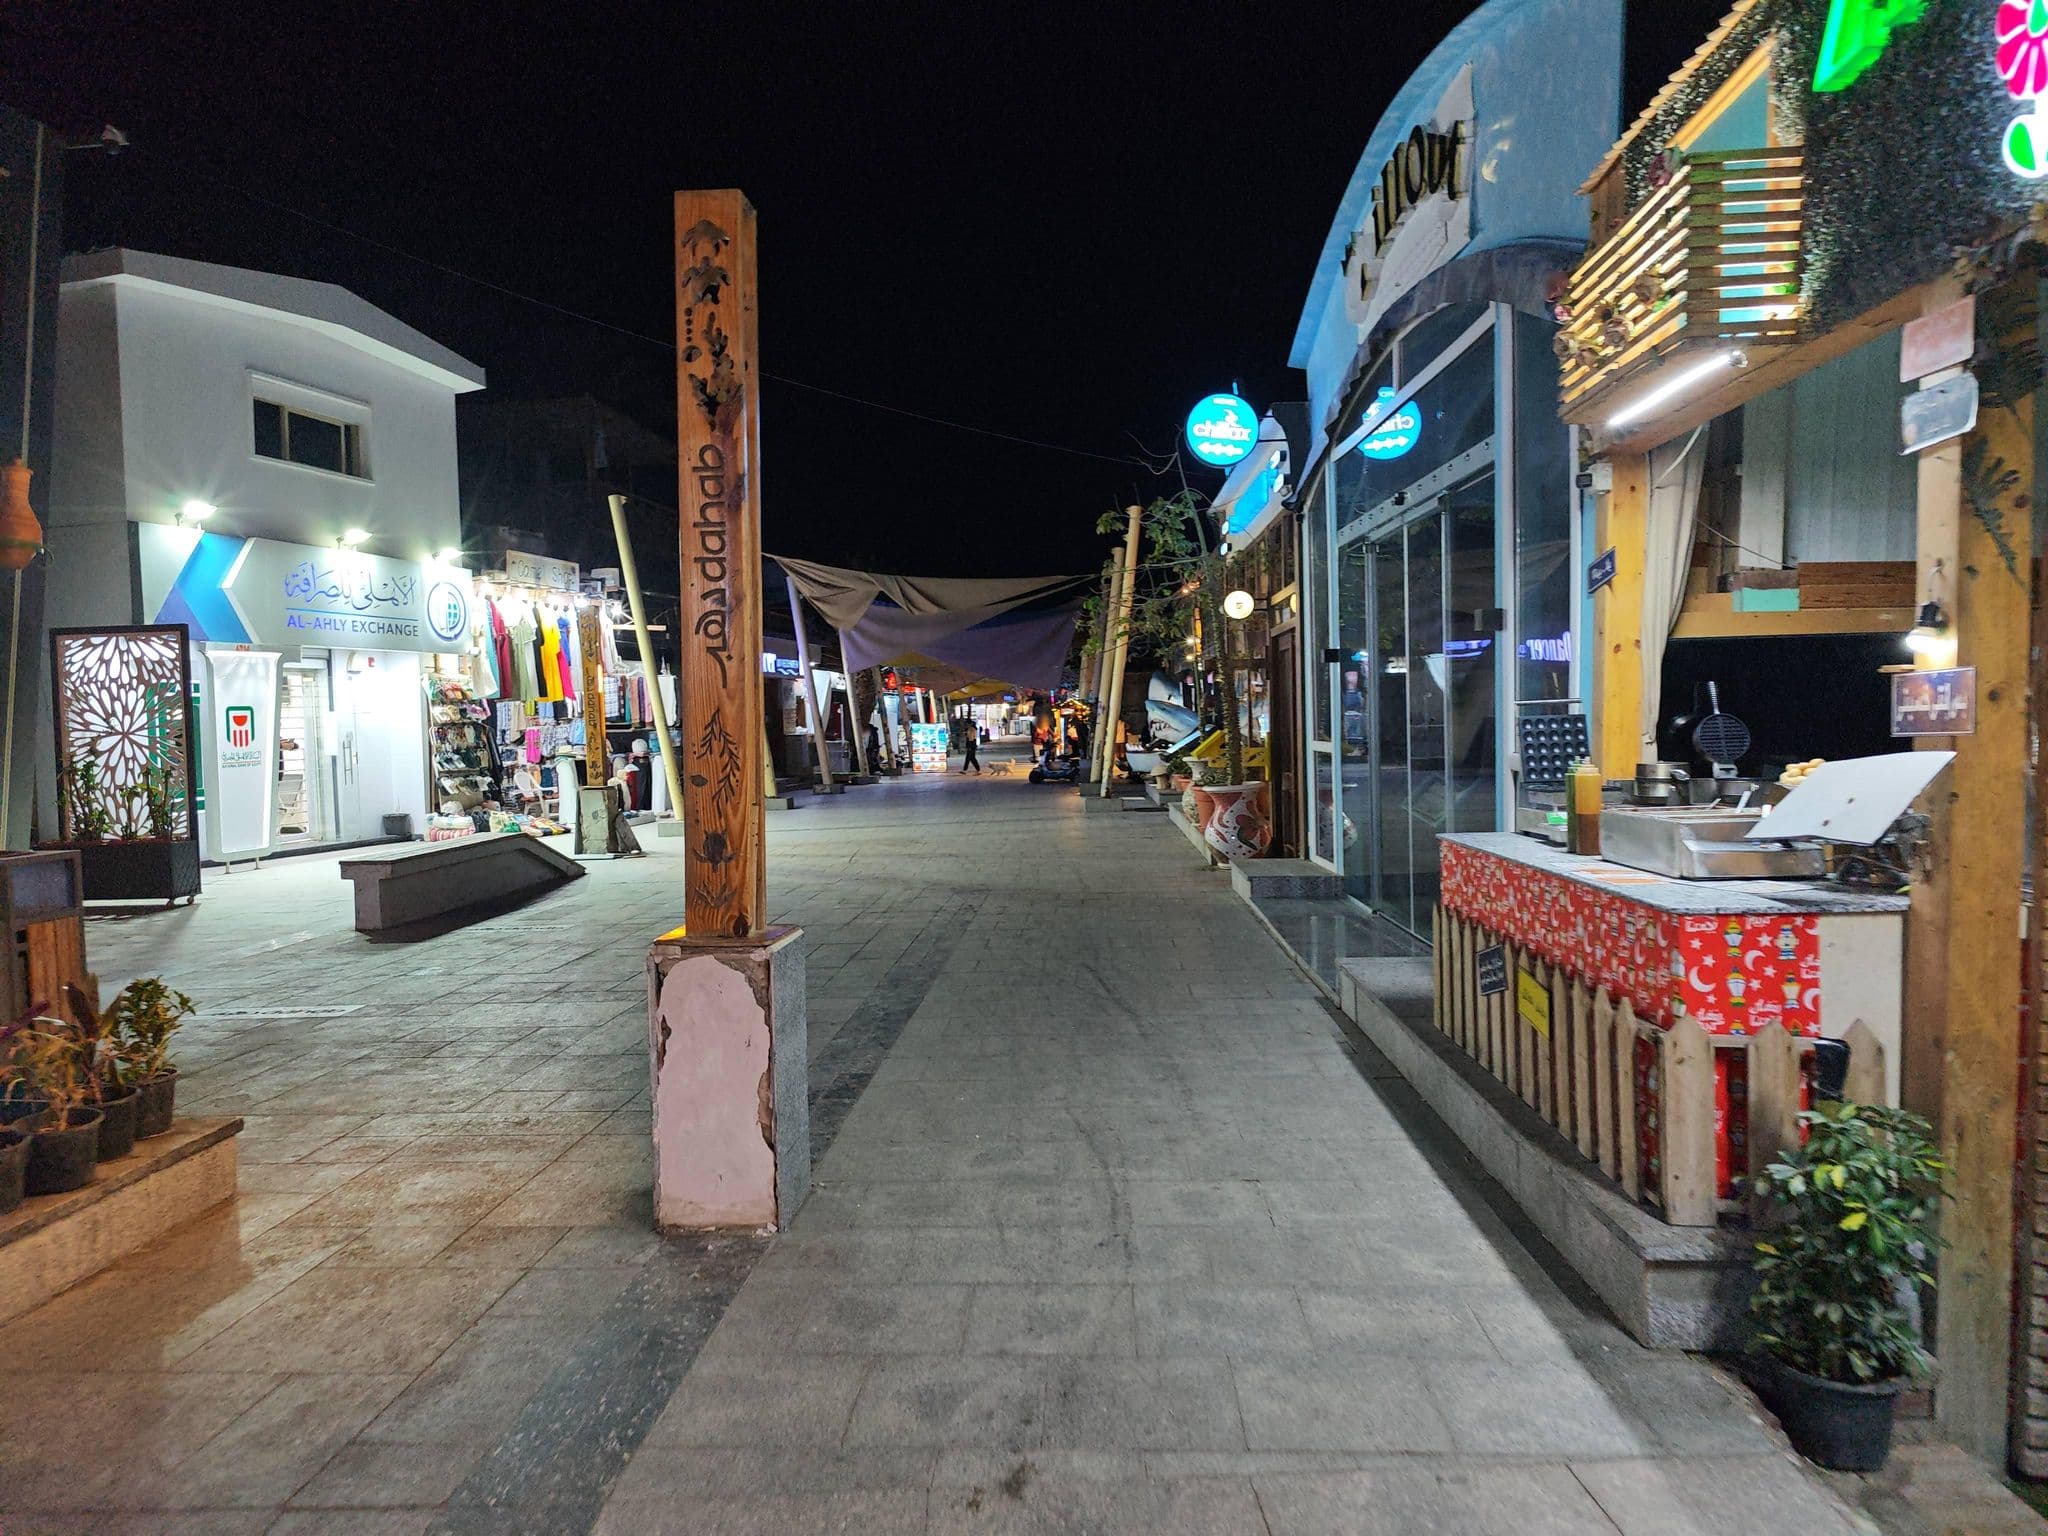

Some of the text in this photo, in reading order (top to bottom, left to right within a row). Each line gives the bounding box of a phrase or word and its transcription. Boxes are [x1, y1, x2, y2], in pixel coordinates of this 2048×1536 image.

[691, 444, 727, 583] dahab
[287, 615, 419, 637] AL-AHLY EXCHANGE
[693, 588, 733, 689] دهب
